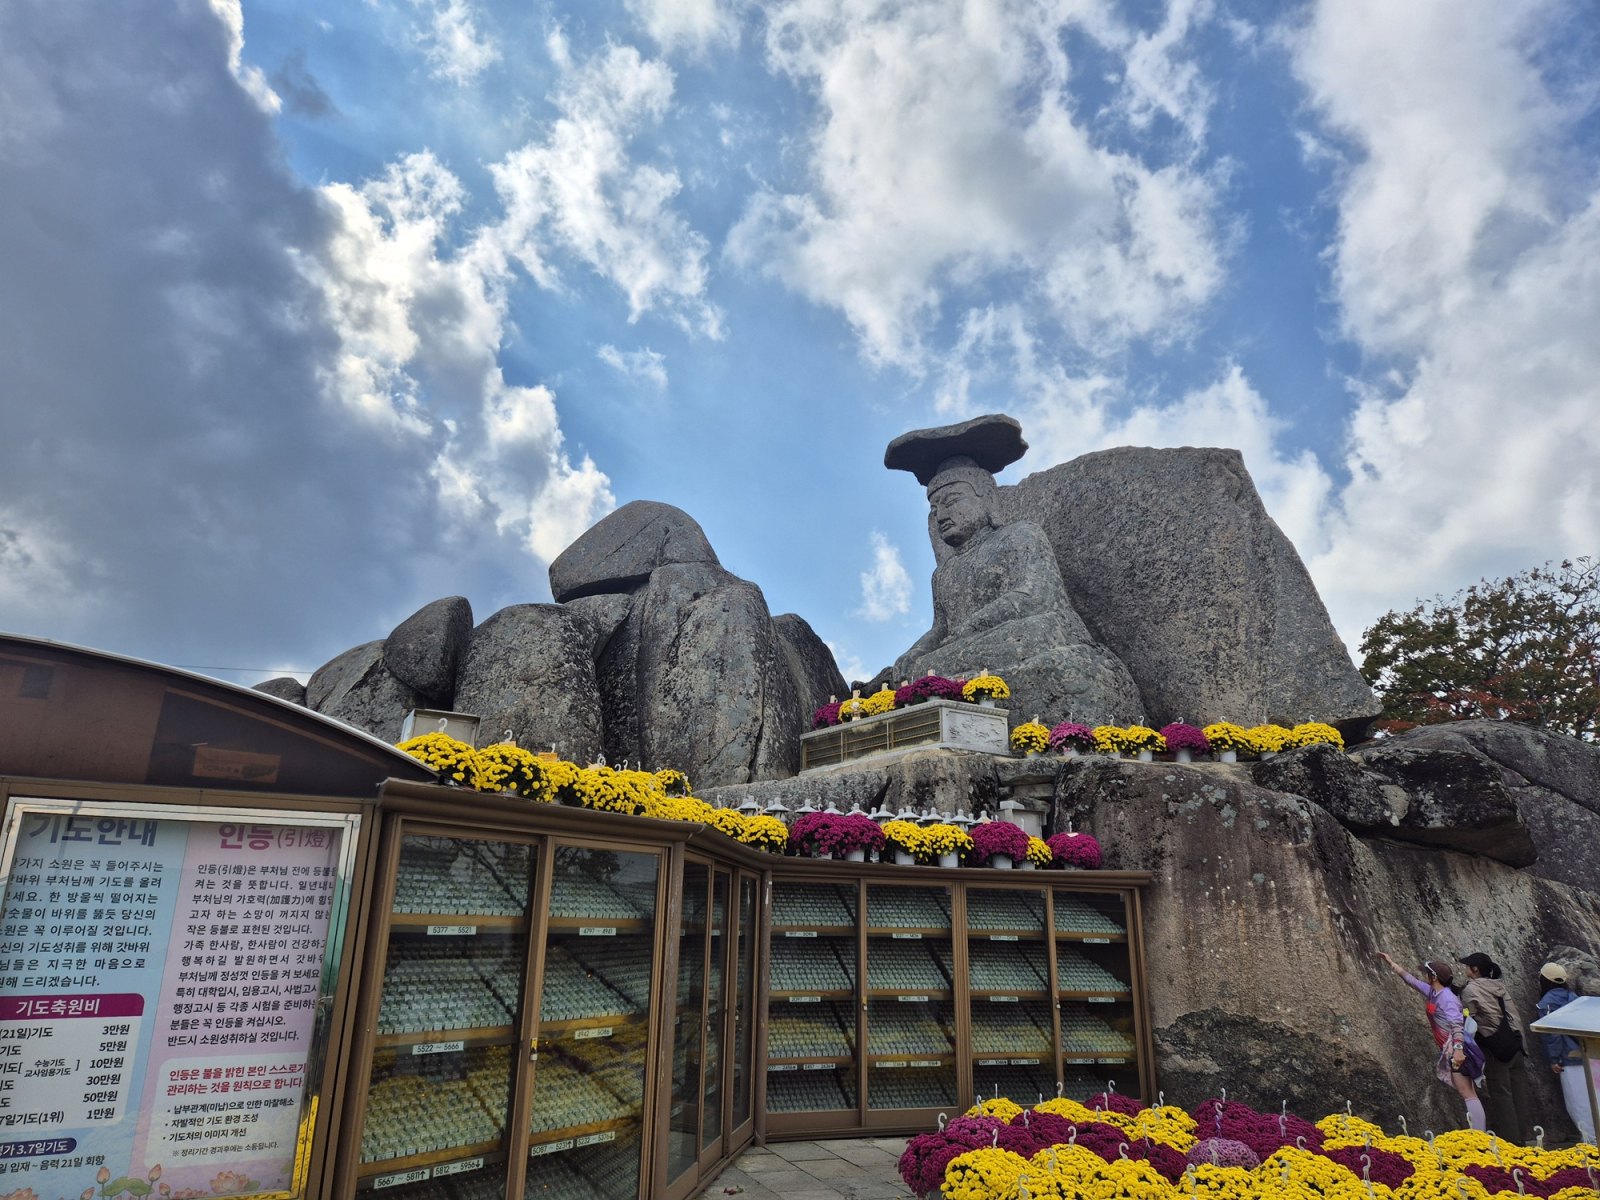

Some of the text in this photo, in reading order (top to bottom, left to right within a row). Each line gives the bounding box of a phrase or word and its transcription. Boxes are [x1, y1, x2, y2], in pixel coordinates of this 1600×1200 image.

[28, 815, 158, 847] 기도안내
[48, 859, 85, 870] 소원은
[90, 859, 101, 871] 꼭
[106, 860, 164, 872] 들어주시는
[259, 865, 288, 876] 부처님
[291, 866, 310, 876] 전에
[45, 875, 94, 887] 부처님께
[99, 876, 134, 888] 기도를
[139, 877, 162, 888] 올려
[194, 879, 216, 890] 켜는
[221, 879, 243, 890] 것을
[248, 880, 294, 891] 뜻합니다.
[49, 892, 61, 903] 한
[67, 892, 104, 904] 방울씩
[110, 893, 159, 904] 떨어지는
[192, 894, 232, 905] 부처님의
[51, 908, 87, 920] 바위를
[92, 908, 117, 920] 뚫듯
[121, 909, 156, 921] 당신의
[188, 909, 211, 920] 고자
[216, 909, 237, 920] 하는
[242, 909, 274, 920] 소망이
[279, 909, 310, 920] 꺼지지
[33, 925, 46, 937] 꼭
[50, 925, 98, 937] 이루어질
[102, 925, 152, 937] 것입니다.
[186, 924, 313, 935] 작은 등불로 표현된 것입니다.
[432, 926, 449, 934] 5377
[458, 926, 472, 934] 5521
[27, 941, 87, 954] 기도성취를
[90, 941, 113, 953] 위해
[116, 941, 150, 953] 갓바위
[183, 939, 205, 951] 가족
[209, 939, 243, 951] 한사람,
[247, 939, 287, 950] 한사람이
[47, 958, 87, 970] 지극한
[94, 958, 146, 970] 마음으로
[181, 955, 227, 967] 행복하길
[234, 954, 290, 966] 발원하면서
[22, 975, 101, 988] 드리겠습니다.
[178, 970, 217, 982] 부처님께
[220, 970, 249, 982] 정성껏
[251, 969, 279, 981] 인등을
[281, 970, 291, 980] 켜
[175, 987, 195, 998] 특히
[197, 986, 240, 998] 대학입시,
[241, 984, 282, 997] 임용고시,
[16, 998, 101, 1017] 기도축원비
[173, 1003, 213, 1015] 행정고시
[216, 1002, 227, 1013] 등
[229, 1001, 249, 1013] 각종
[251, 1000, 281, 1012] 시험을
[102, 1024, 130, 1035] 3만원
[169, 1016, 286, 1031] 분들은 꼭 인등을 켜십시오.
[167, 1030, 300, 1047] 반드시 소원성취하실 것입니다.
[98, 1041, 127, 1052] 5만원
[417, 1044, 434, 1053] 5522
[443, 1043, 460, 1051] 5666
[34, 1058, 65, 1068] 수능기도
[89, 1057, 124, 1069] 10만원
[24, 1067, 71, 1077] 교사임용기도
[169, 1069, 200, 1081] 인등은
[202, 1067, 223, 1079] 불을
[225, 1066, 245, 1078] 밝힌
[247, 1065, 267, 1077] 본인
[86, 1074, 121, 1085] 30만원
[166, 1083, 208, 1096] 관리하는
[210, 1081, 231, 1093] 것을
[233, 1079, 271, 1092] 원칙으로
[82, 1090, 118, 1103] 50만원
[246, 1099, 263, 1110] 인한
[263, 1098, 295, 1109] 마찰해소
[86, 1107, 115, 1120] 1만원
[171, 1113, 259, 1128] 자발적인 기도 환경 조성
[168, 1127, 247, 1143] 기도처의 이미지 개선
[16, 1140, 69, 1155] 3.7일기도
[10, 1161, 31, 1173] 입재
[39, 1159, 60, 1171] 음력
[60, 1156, 84, 1168] 21일
[85, 1155, 105, 1166] 회향
[435, 1165, 450, 1175] 5812
[460, 1160, 476, 1171] 5956
[377, 1176, 395, 1187] 5667
[406, 1171, 420, 1182] 5811
